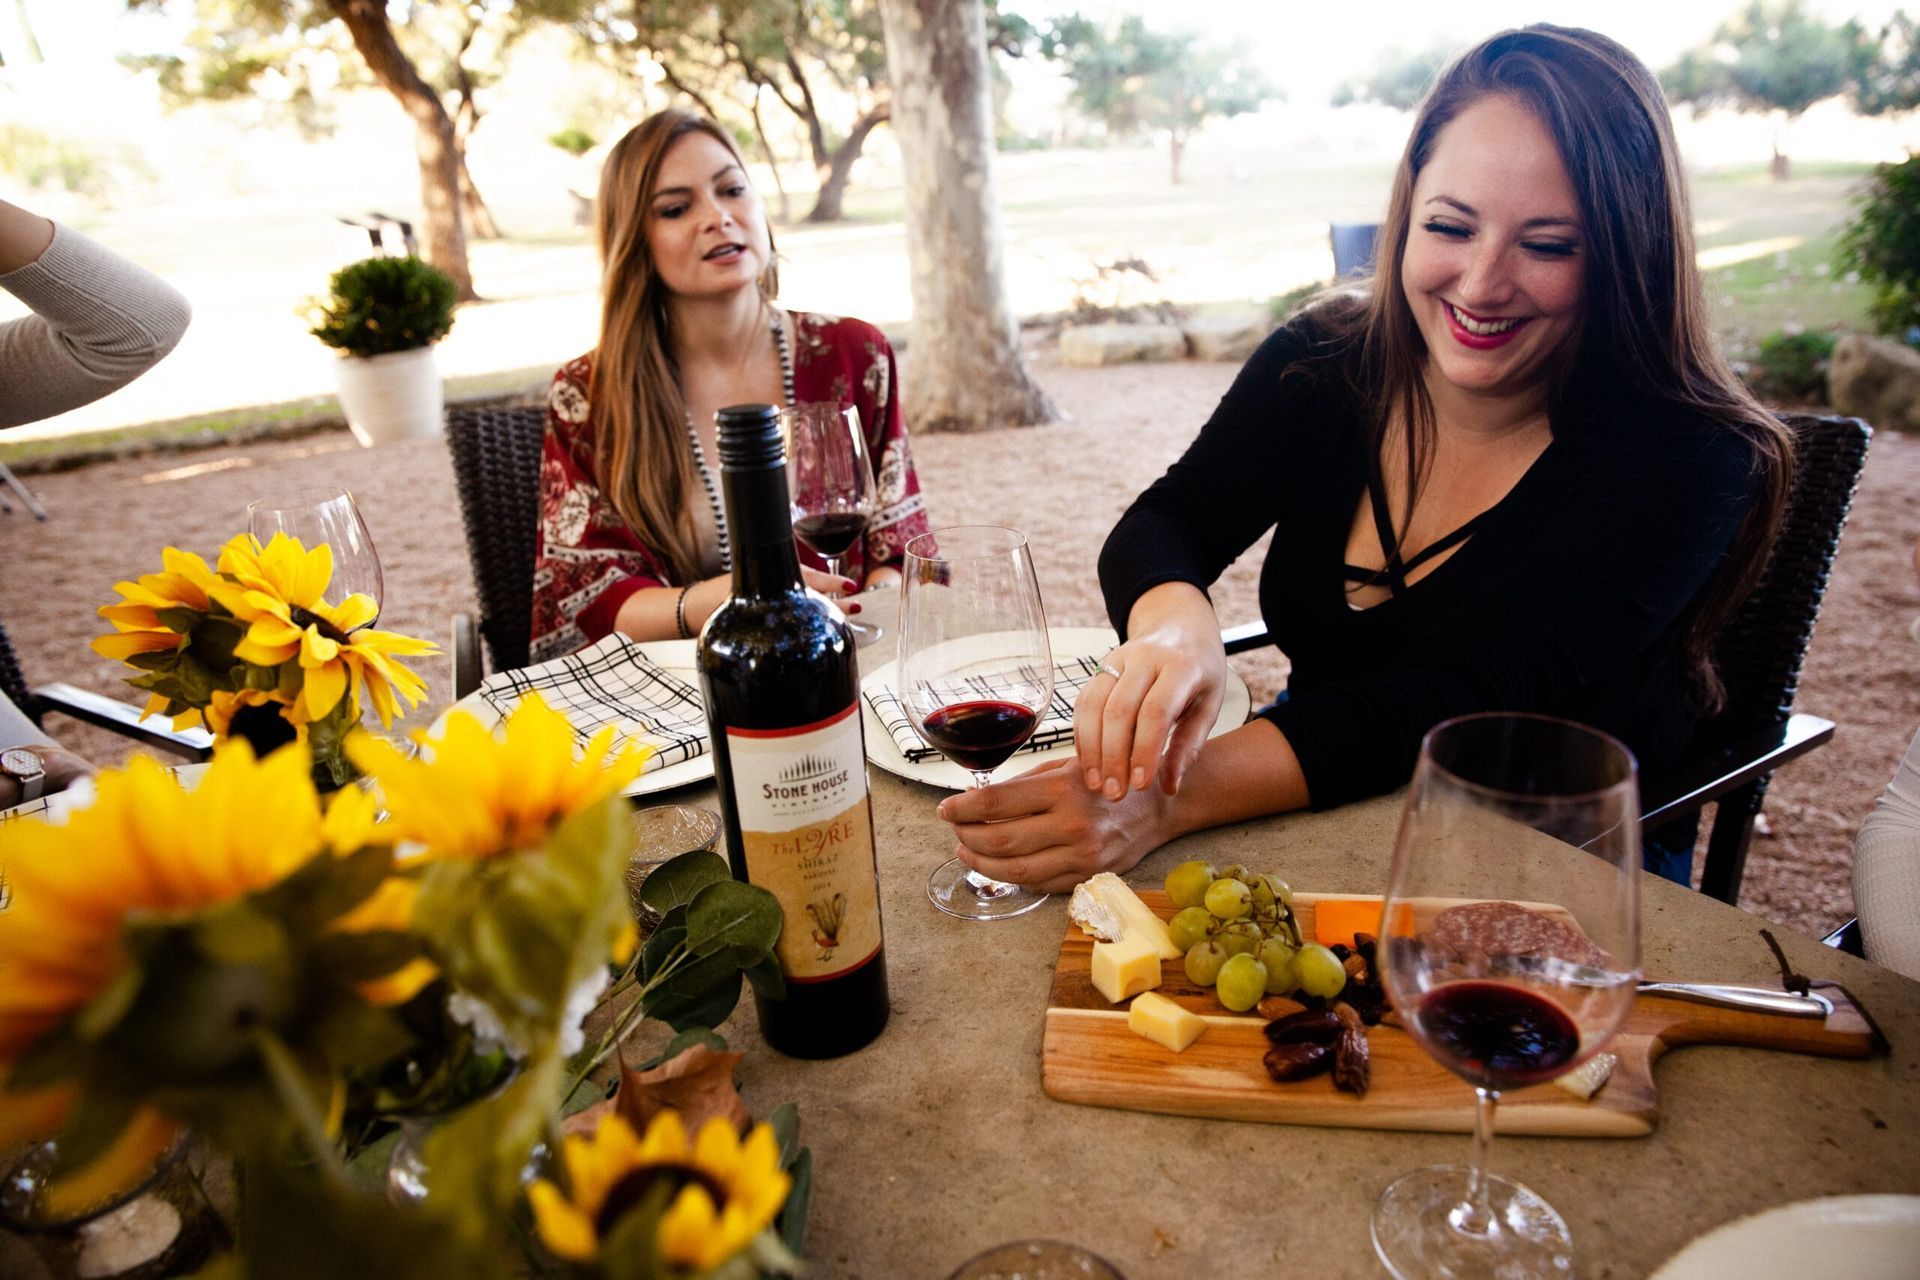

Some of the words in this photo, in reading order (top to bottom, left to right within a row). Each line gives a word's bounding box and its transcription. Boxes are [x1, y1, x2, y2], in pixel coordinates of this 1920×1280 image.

[762, 783, 809, 799] STONE
[812, 769, 849, 793] HOUSE
[797, 853, 838, 870] SHIRAZ
